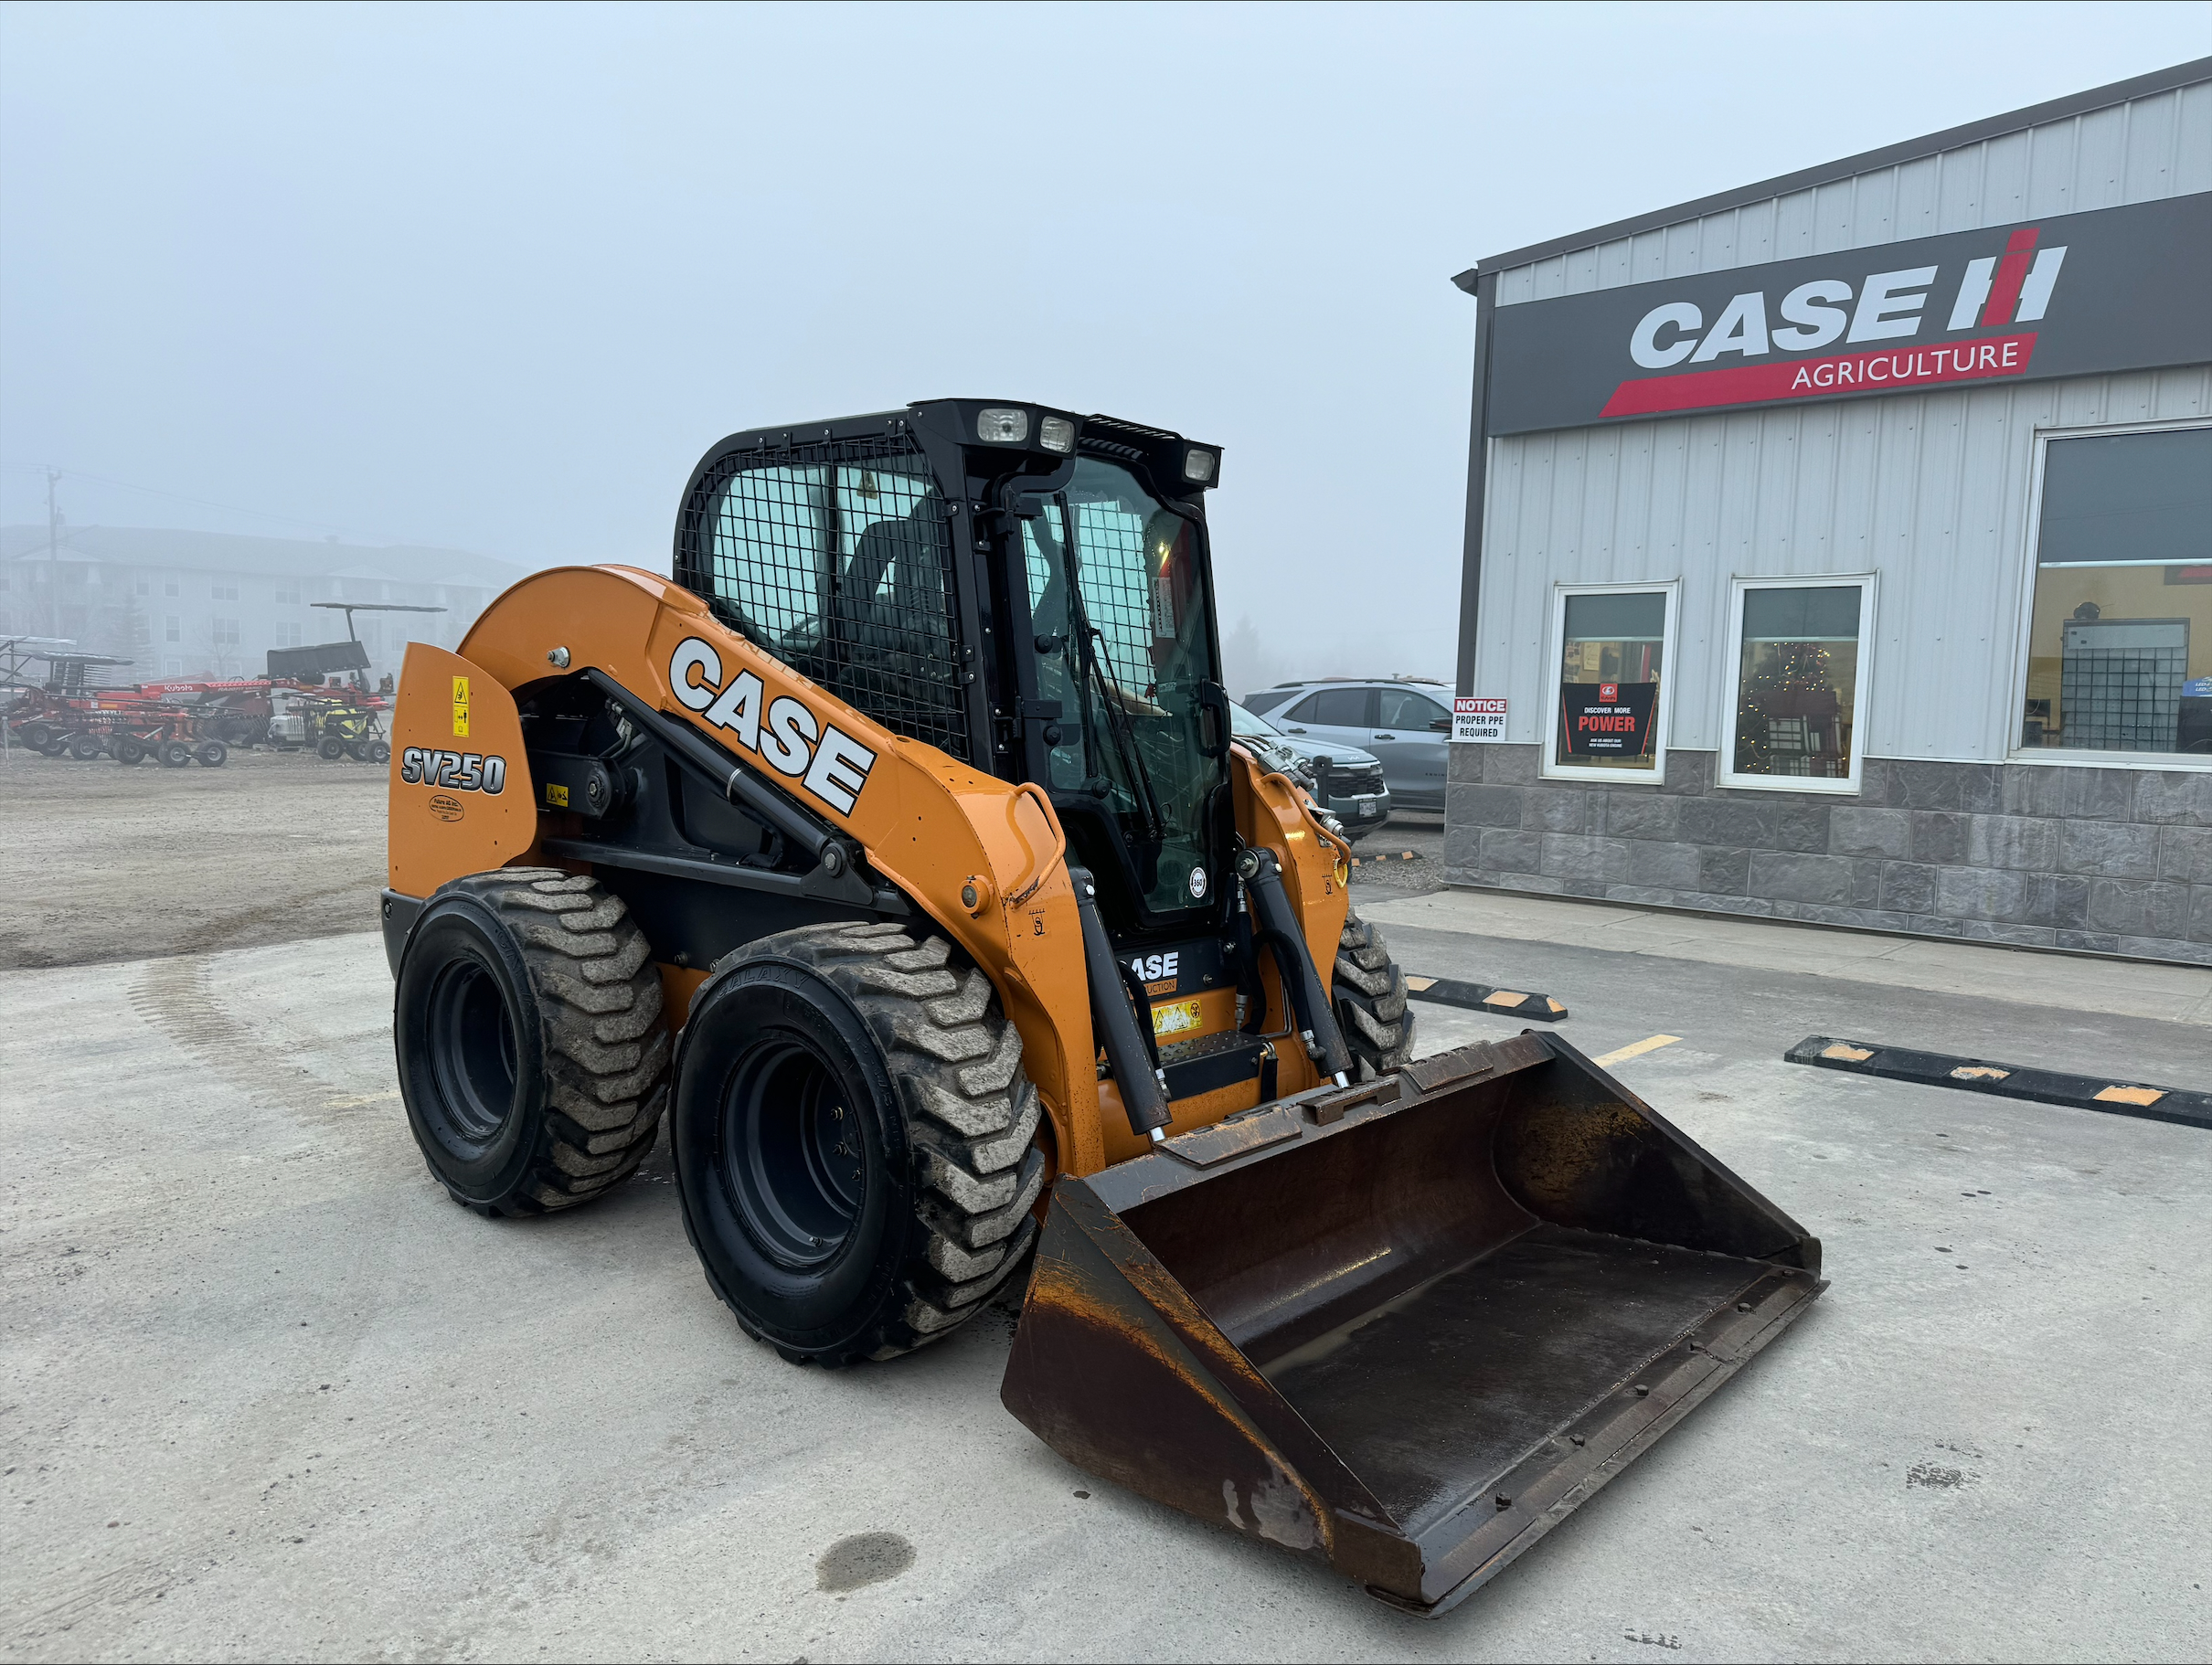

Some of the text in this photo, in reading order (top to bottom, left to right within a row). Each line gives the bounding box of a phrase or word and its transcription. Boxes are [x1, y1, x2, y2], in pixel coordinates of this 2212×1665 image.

[1630, 265, 1939, 369] CASE
[1791, 341, 2019, 390] AGRICULTURE
[1455, 716, 1505, 726] PROPER PPE
[1456, 700, 1506, 712] NOTICE
[668, 635, 878, 819] CASE
[1459, 727, 1499, 737] REQUIRED
[1578, 716, 1636, 732] POWER
[400, 747, 507, 796] SV250
[1120, 951, 1179, 981] ASE
[717, 966, 811, 999] GALAXY
[1146, 981, 1175, 994] UCTION
